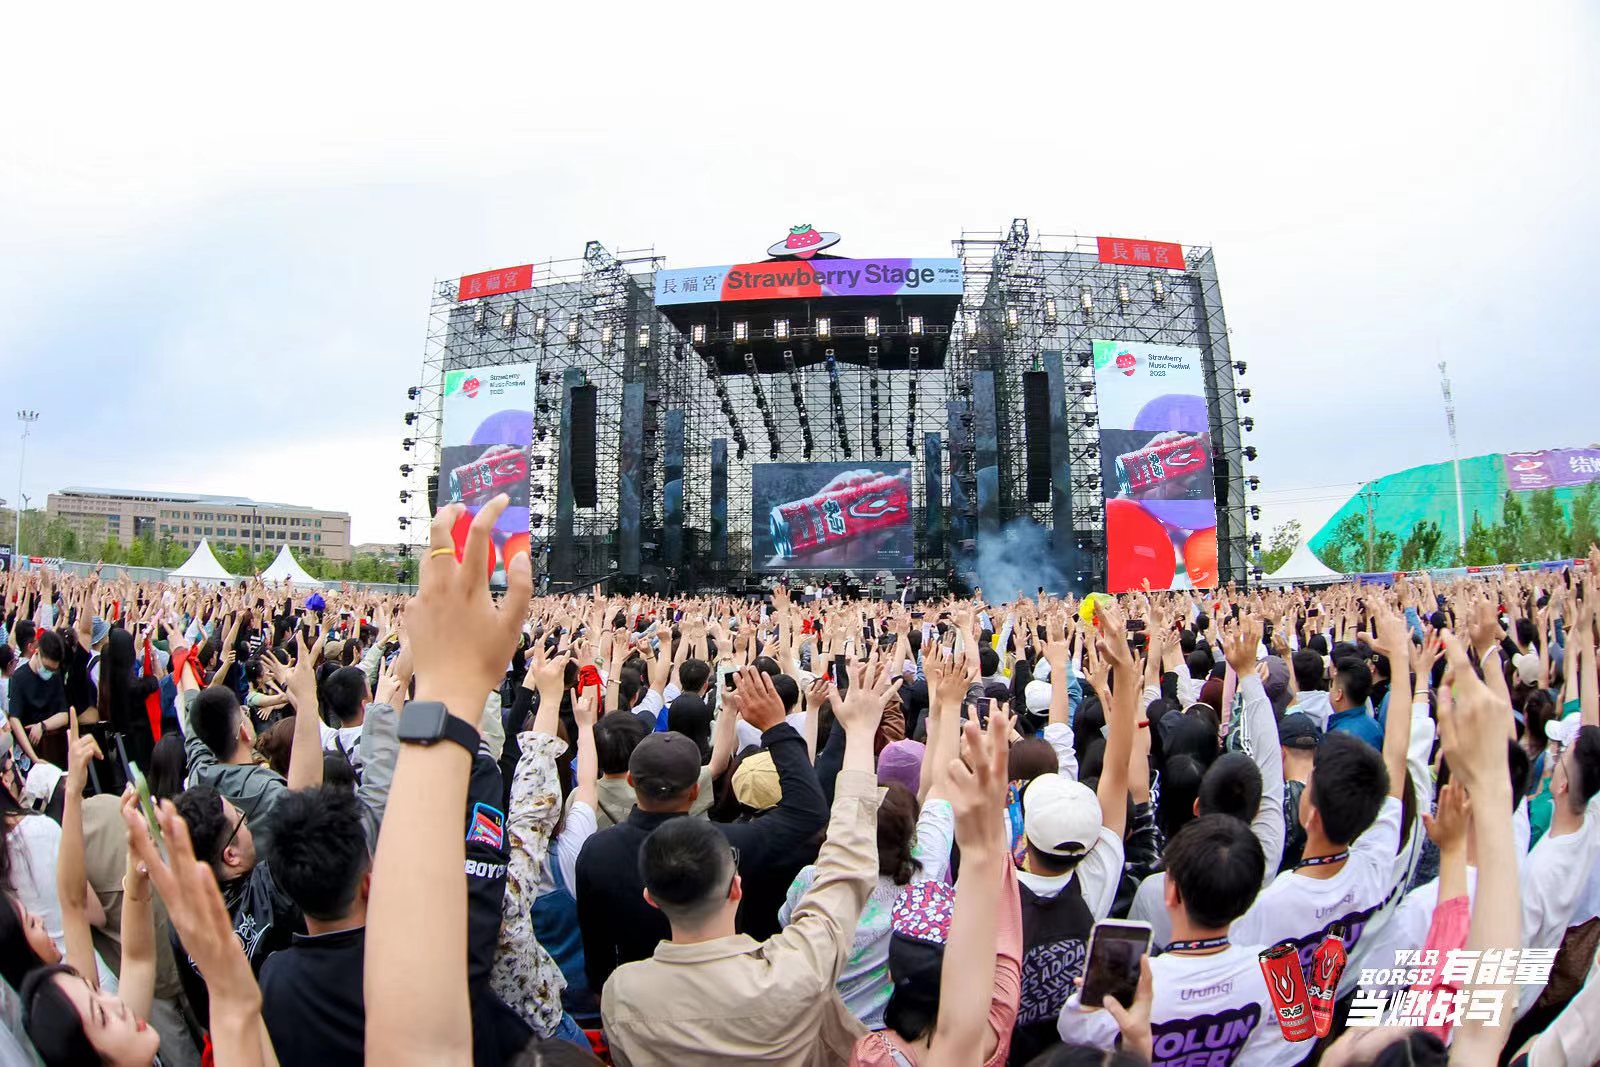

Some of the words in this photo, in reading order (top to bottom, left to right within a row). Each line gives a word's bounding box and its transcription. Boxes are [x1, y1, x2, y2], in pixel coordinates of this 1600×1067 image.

[1112, 242, 1169, 263] 長福宮
[663, 274, 718, 294] 長福宮
[727, 267, 861, 289] Strawberry
[865, 263, 935, 288] Stage
[1148, 353, 1183, 362] Strawberry
[1181, 982, 1233, 1001] Urumqi
